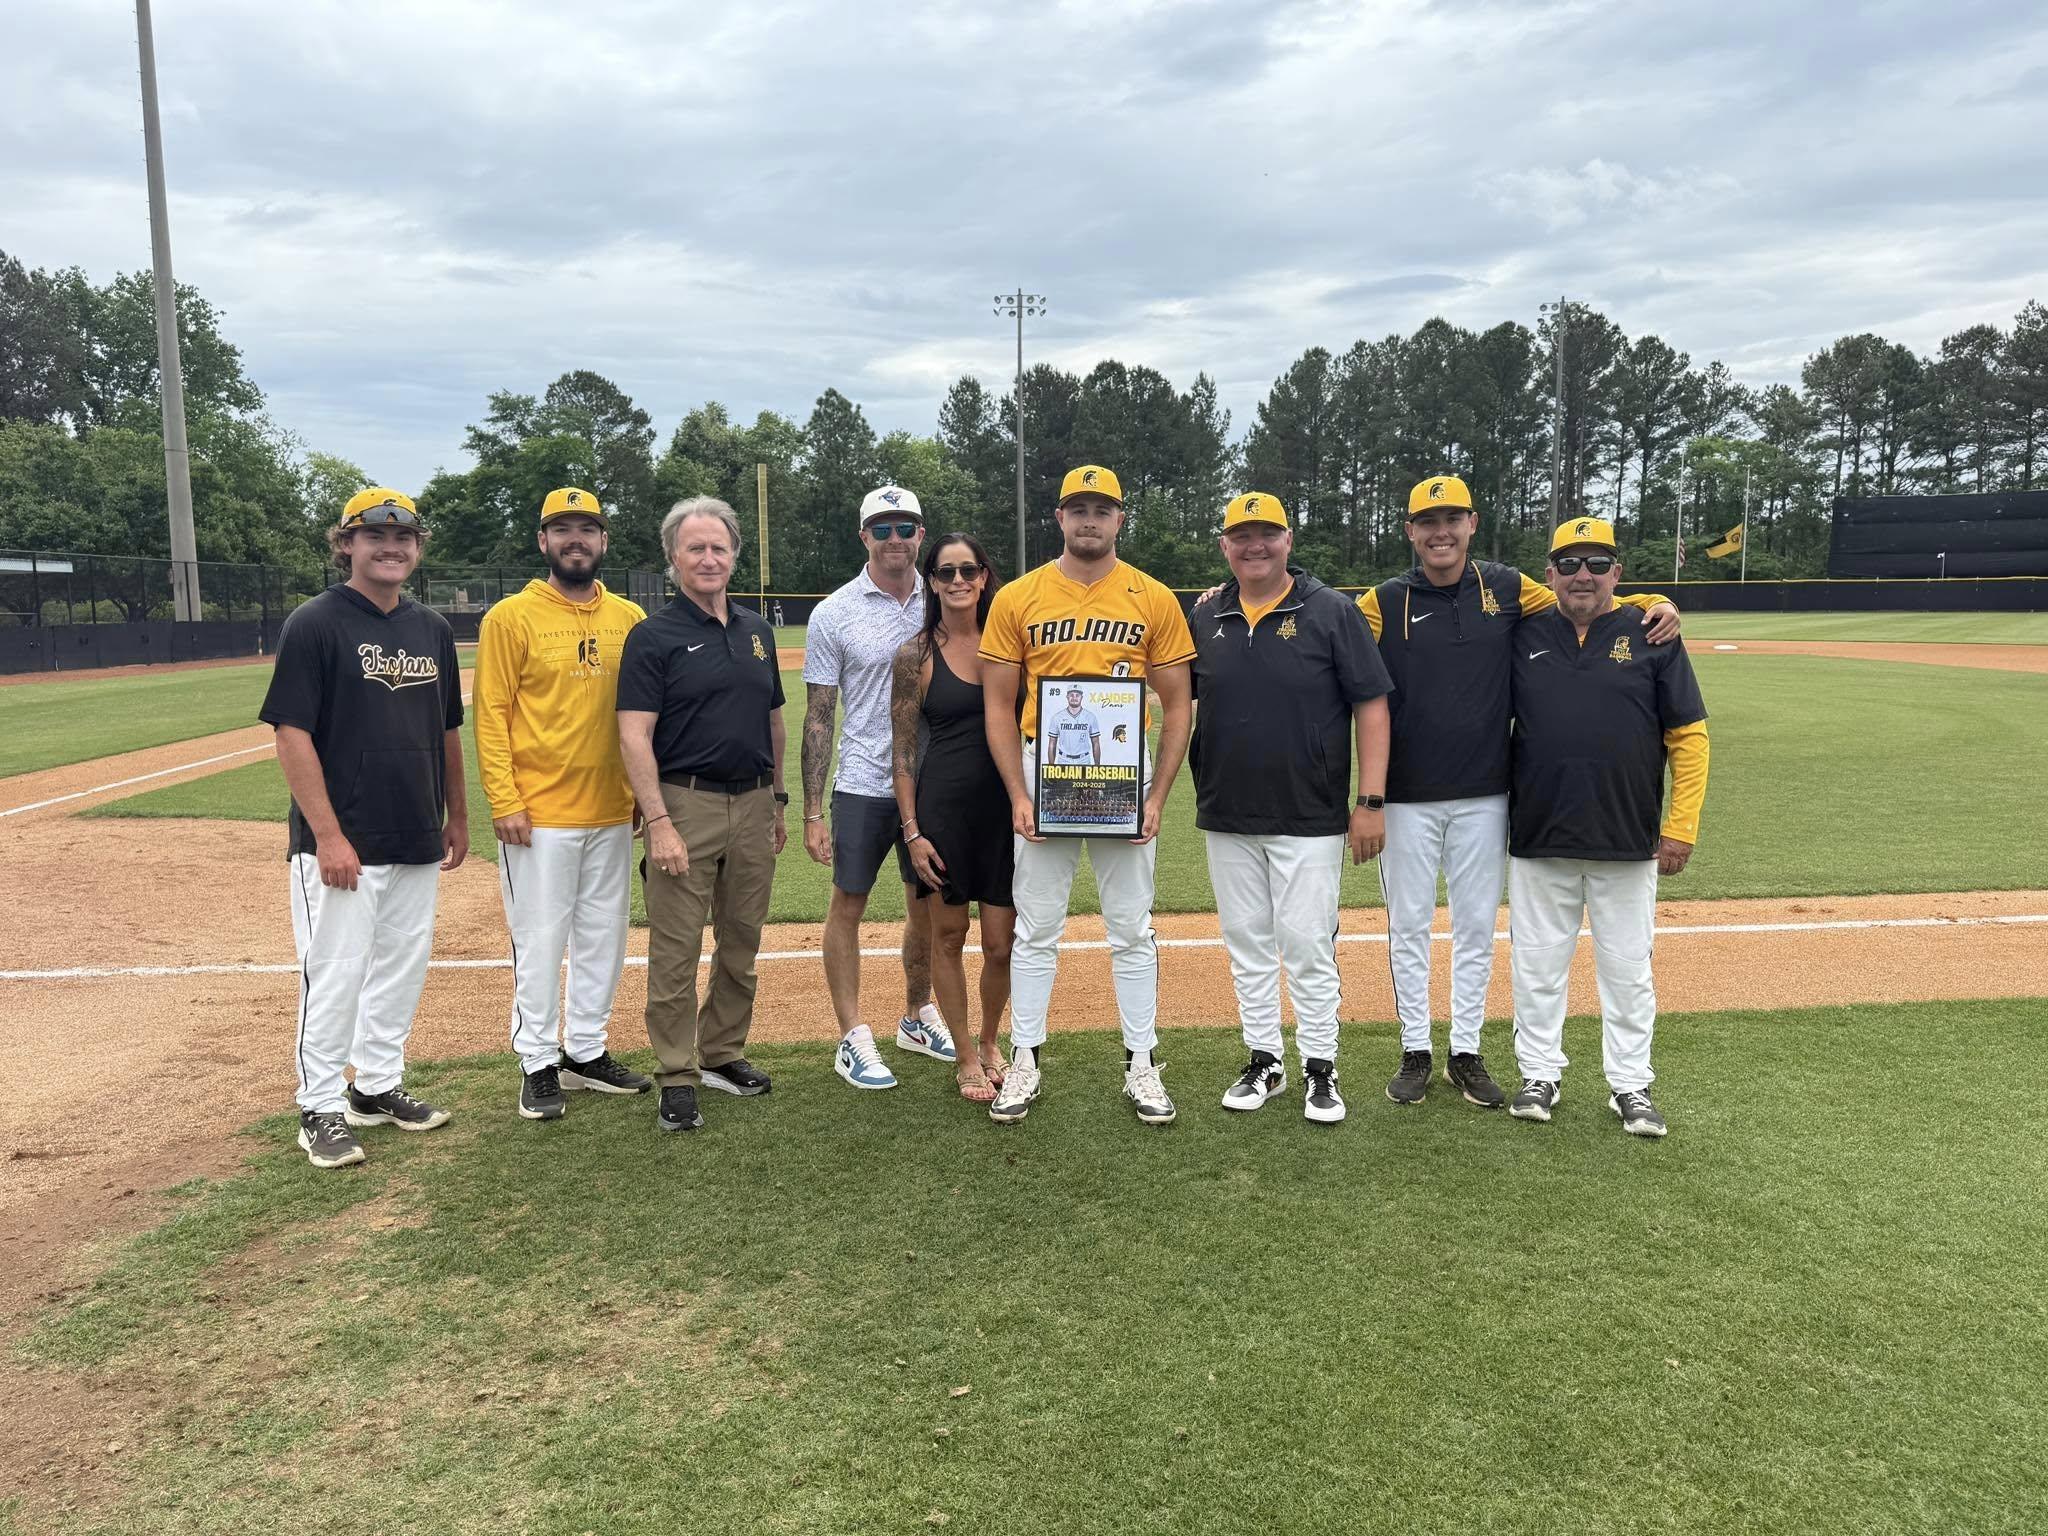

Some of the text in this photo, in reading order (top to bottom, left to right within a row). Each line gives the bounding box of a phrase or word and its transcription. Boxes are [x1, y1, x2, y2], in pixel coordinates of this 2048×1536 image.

[604, 628, 625, 636] TECH
[1027, 617, 1146, 647] TROJANS
[358, 643, 437, 685] Trojans
[1049, 687, 1061, 696] #9
[1090, 692, 1136, 704] XANDER
[1060, 723, 1089, 731] TROJANS
[1042, 765, 1137, 780] TROJAN BASEBALL
